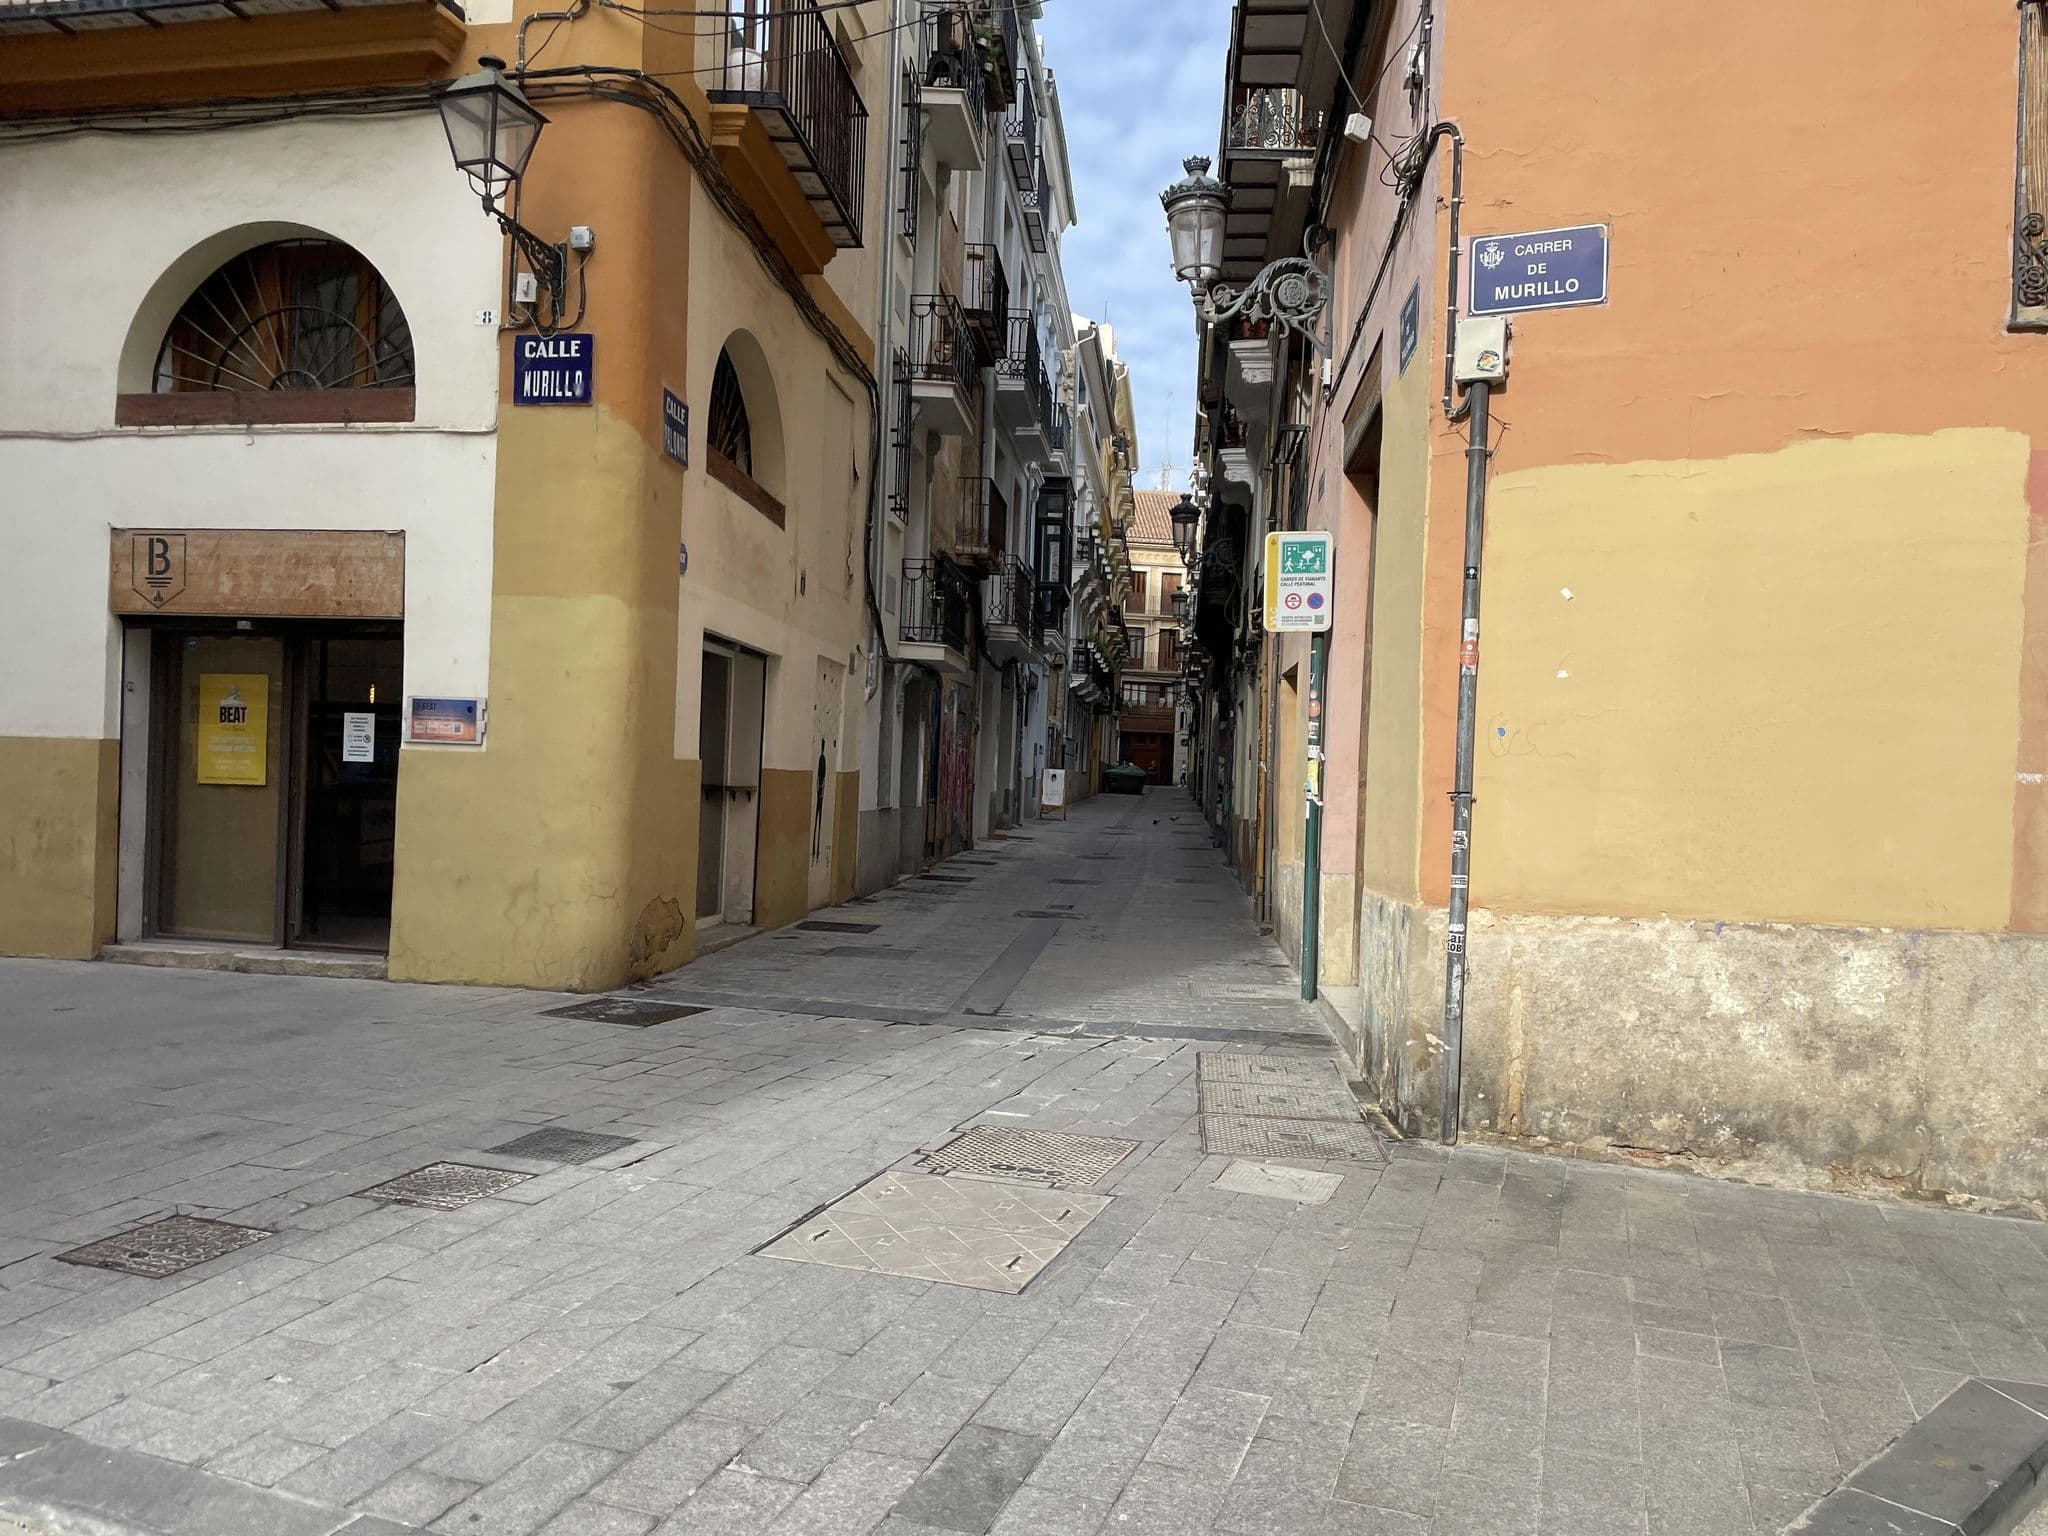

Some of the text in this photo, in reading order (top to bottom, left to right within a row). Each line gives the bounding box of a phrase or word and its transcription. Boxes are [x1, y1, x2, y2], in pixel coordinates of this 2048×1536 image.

[1515, 239, 1572, 256] CARRER
[1527, 263, 1547, 275] DE
[1495, 278, 1579, 300] MURILLO
[482, 310, 491, 324] 8
[524, 340, 581, 358] CALLE
[523, 370, 584, 397] MURILLO
[666, 396, 685, 426] CALLE
[148, 537, 170, 575] B
[220, 706, 247, 724] BEAT
